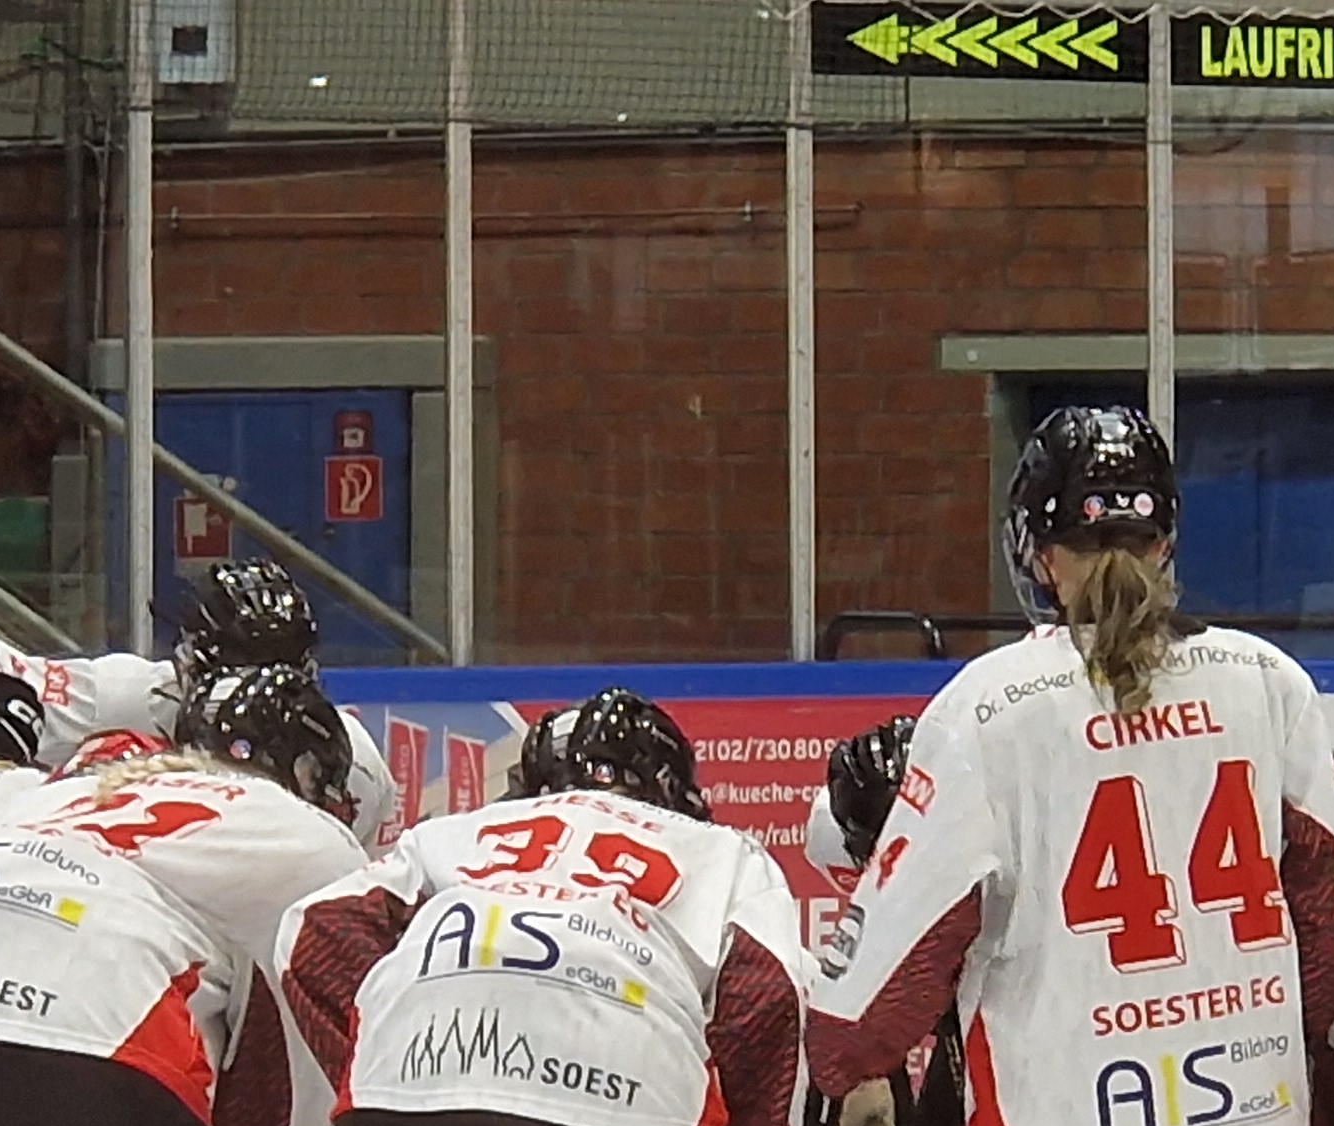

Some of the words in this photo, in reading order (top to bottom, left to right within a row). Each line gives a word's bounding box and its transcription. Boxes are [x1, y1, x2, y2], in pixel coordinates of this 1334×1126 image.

[975, 702, 1005, 725] Dr.
[1004, 670, 1075, 705] Becker
[1085, 700, 1224, 751] CIRKEL
[455, 815, 681, 908] 39
[1063, 760, 1295, 974] 44
[419, 902, 562, 975] AIS
[568, 912, 654, 966] Bildung
[1093, 983, 1245, 1037] SOESTER
[1249, 974, 1286, 1010] EG
[540, 1058, 643, 1106] SOEST
